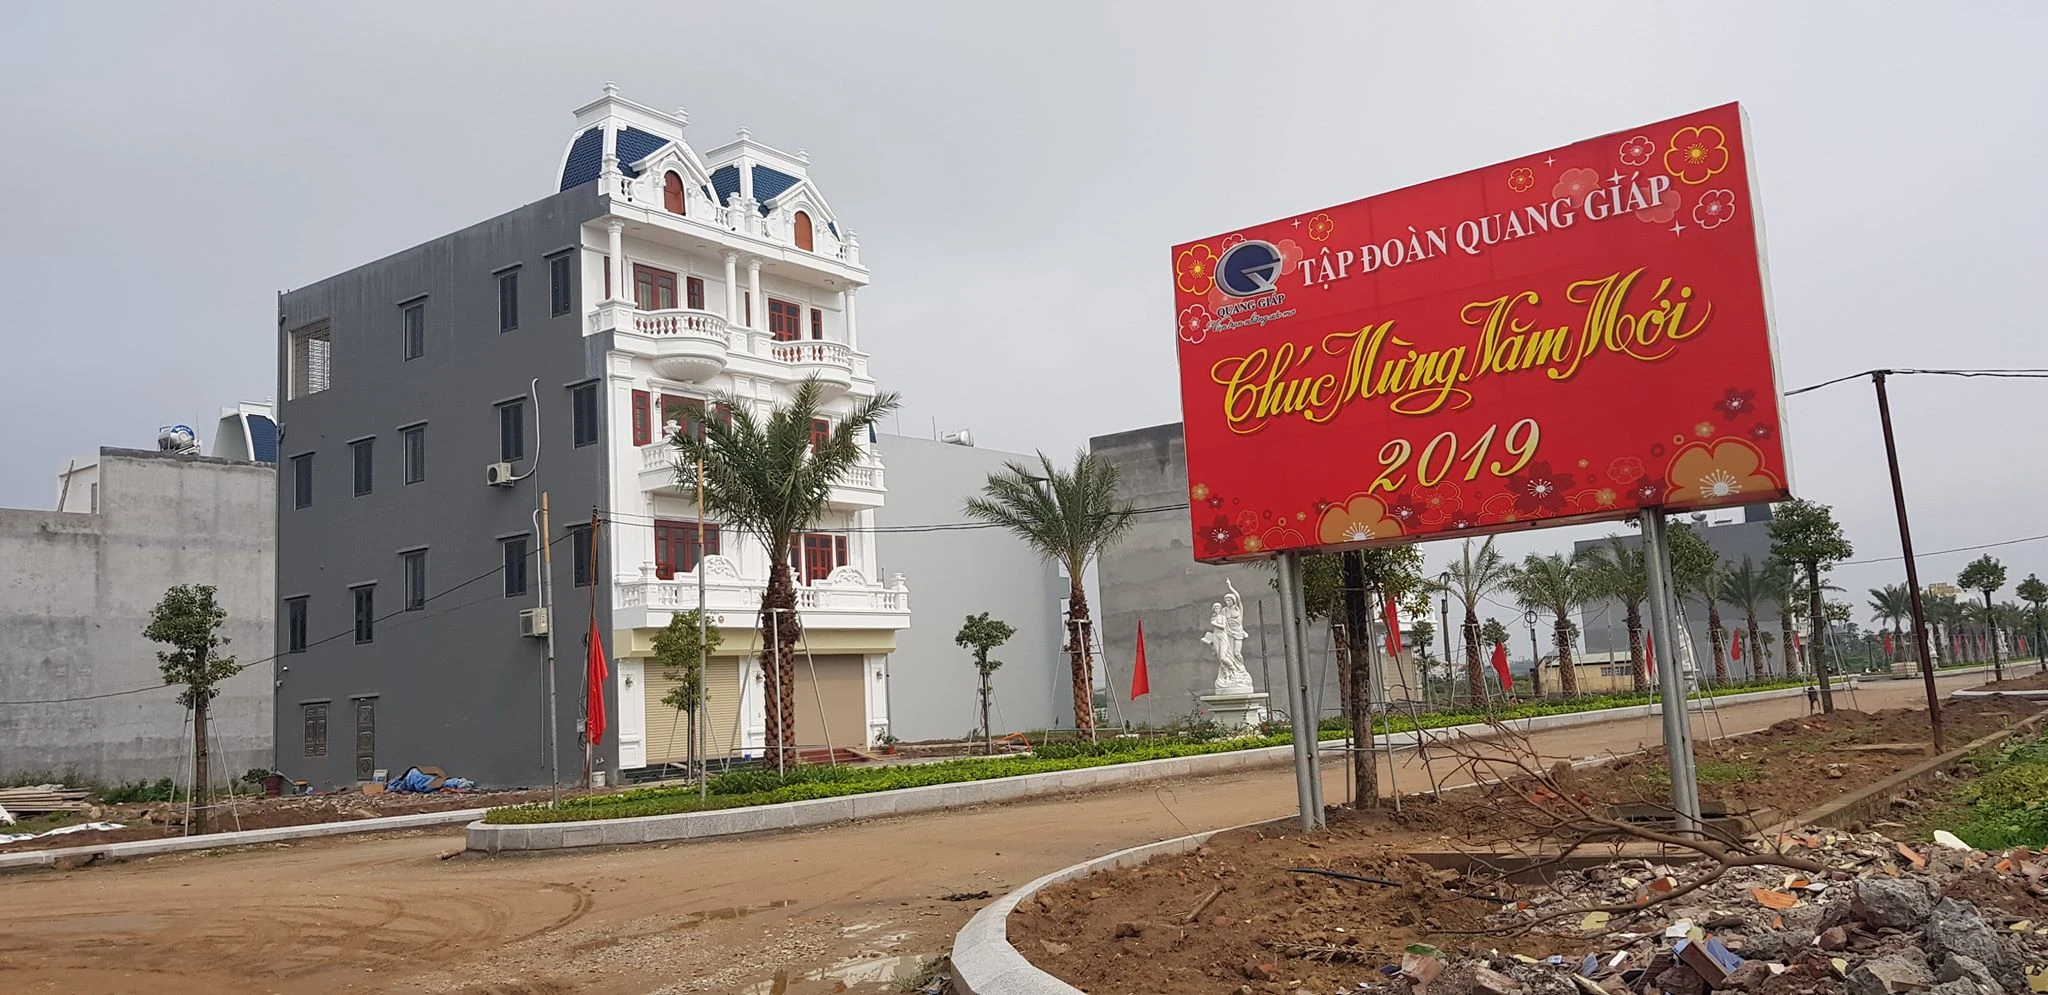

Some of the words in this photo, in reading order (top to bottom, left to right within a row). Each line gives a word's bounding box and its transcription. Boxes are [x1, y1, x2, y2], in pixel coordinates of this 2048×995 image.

[1298, 247, 1354, 290] TẬP
[1360, 225, 1448, 273] ĐOÀN
[1456, 198, 1576, 255] QUANG
[1584, 170, 1670, 220] GIÁP
[1210, 342, 1340, 434] Chúc
[1303, 319, 1473, 415] Mừng
[1457, 290, 1573, 383] Năm
[1547, 265, 1712, 380] Mới
[1217, 301, 1256, 317] QUANG
[1257, 293, 1285, 307] GIÁP
[1368, 418, 1540, 495] 2019
